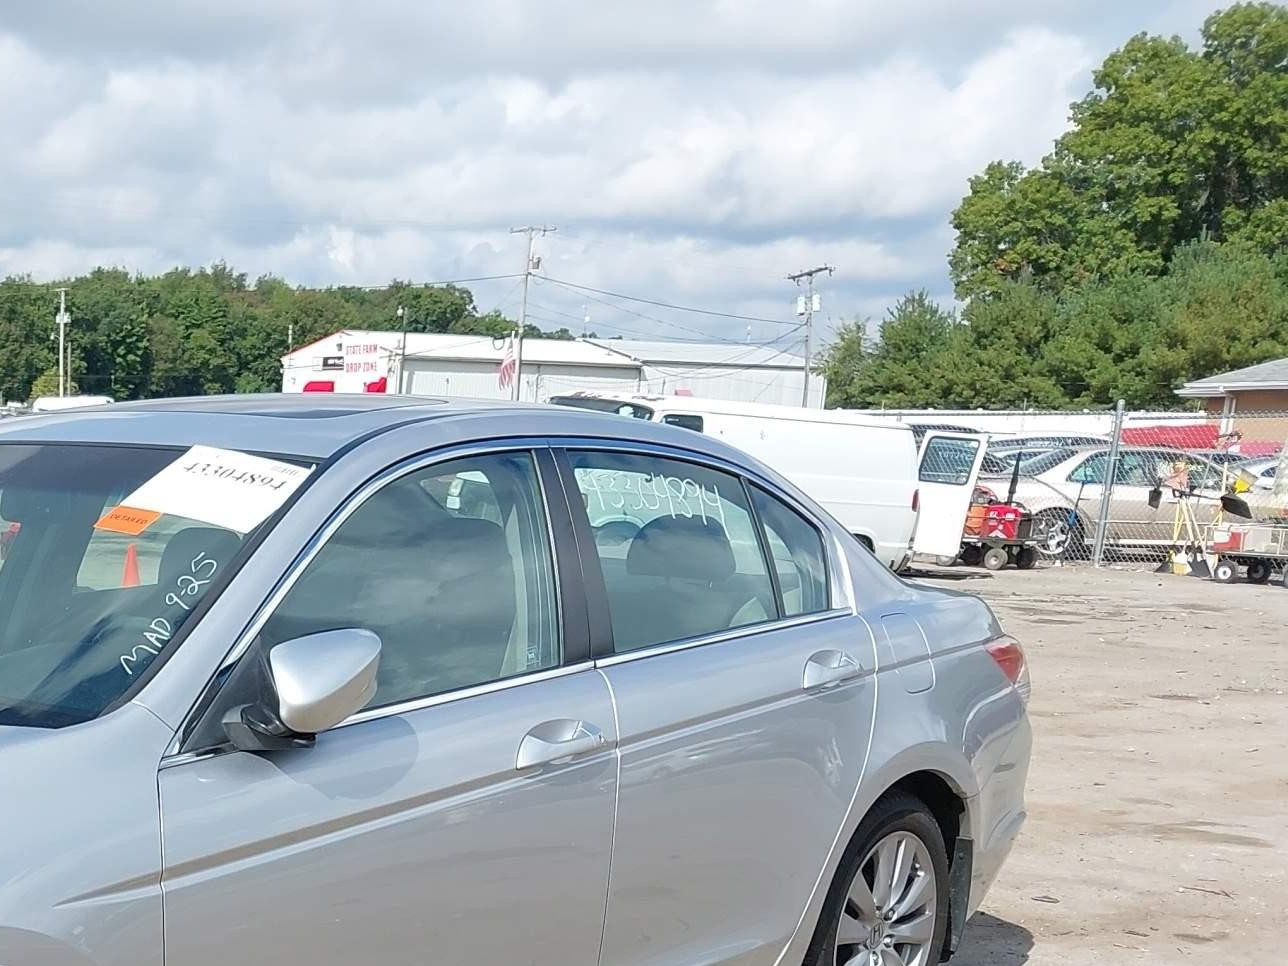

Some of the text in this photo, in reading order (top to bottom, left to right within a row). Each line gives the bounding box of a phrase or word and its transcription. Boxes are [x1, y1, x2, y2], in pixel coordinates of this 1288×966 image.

[346, 343, 377, 355] STATE FARM
[346, 361, 377, 373] DROP ZONE
[183, 461, 288, 491] 43304894
[120, 551, 217, 675] MAD 9-25
